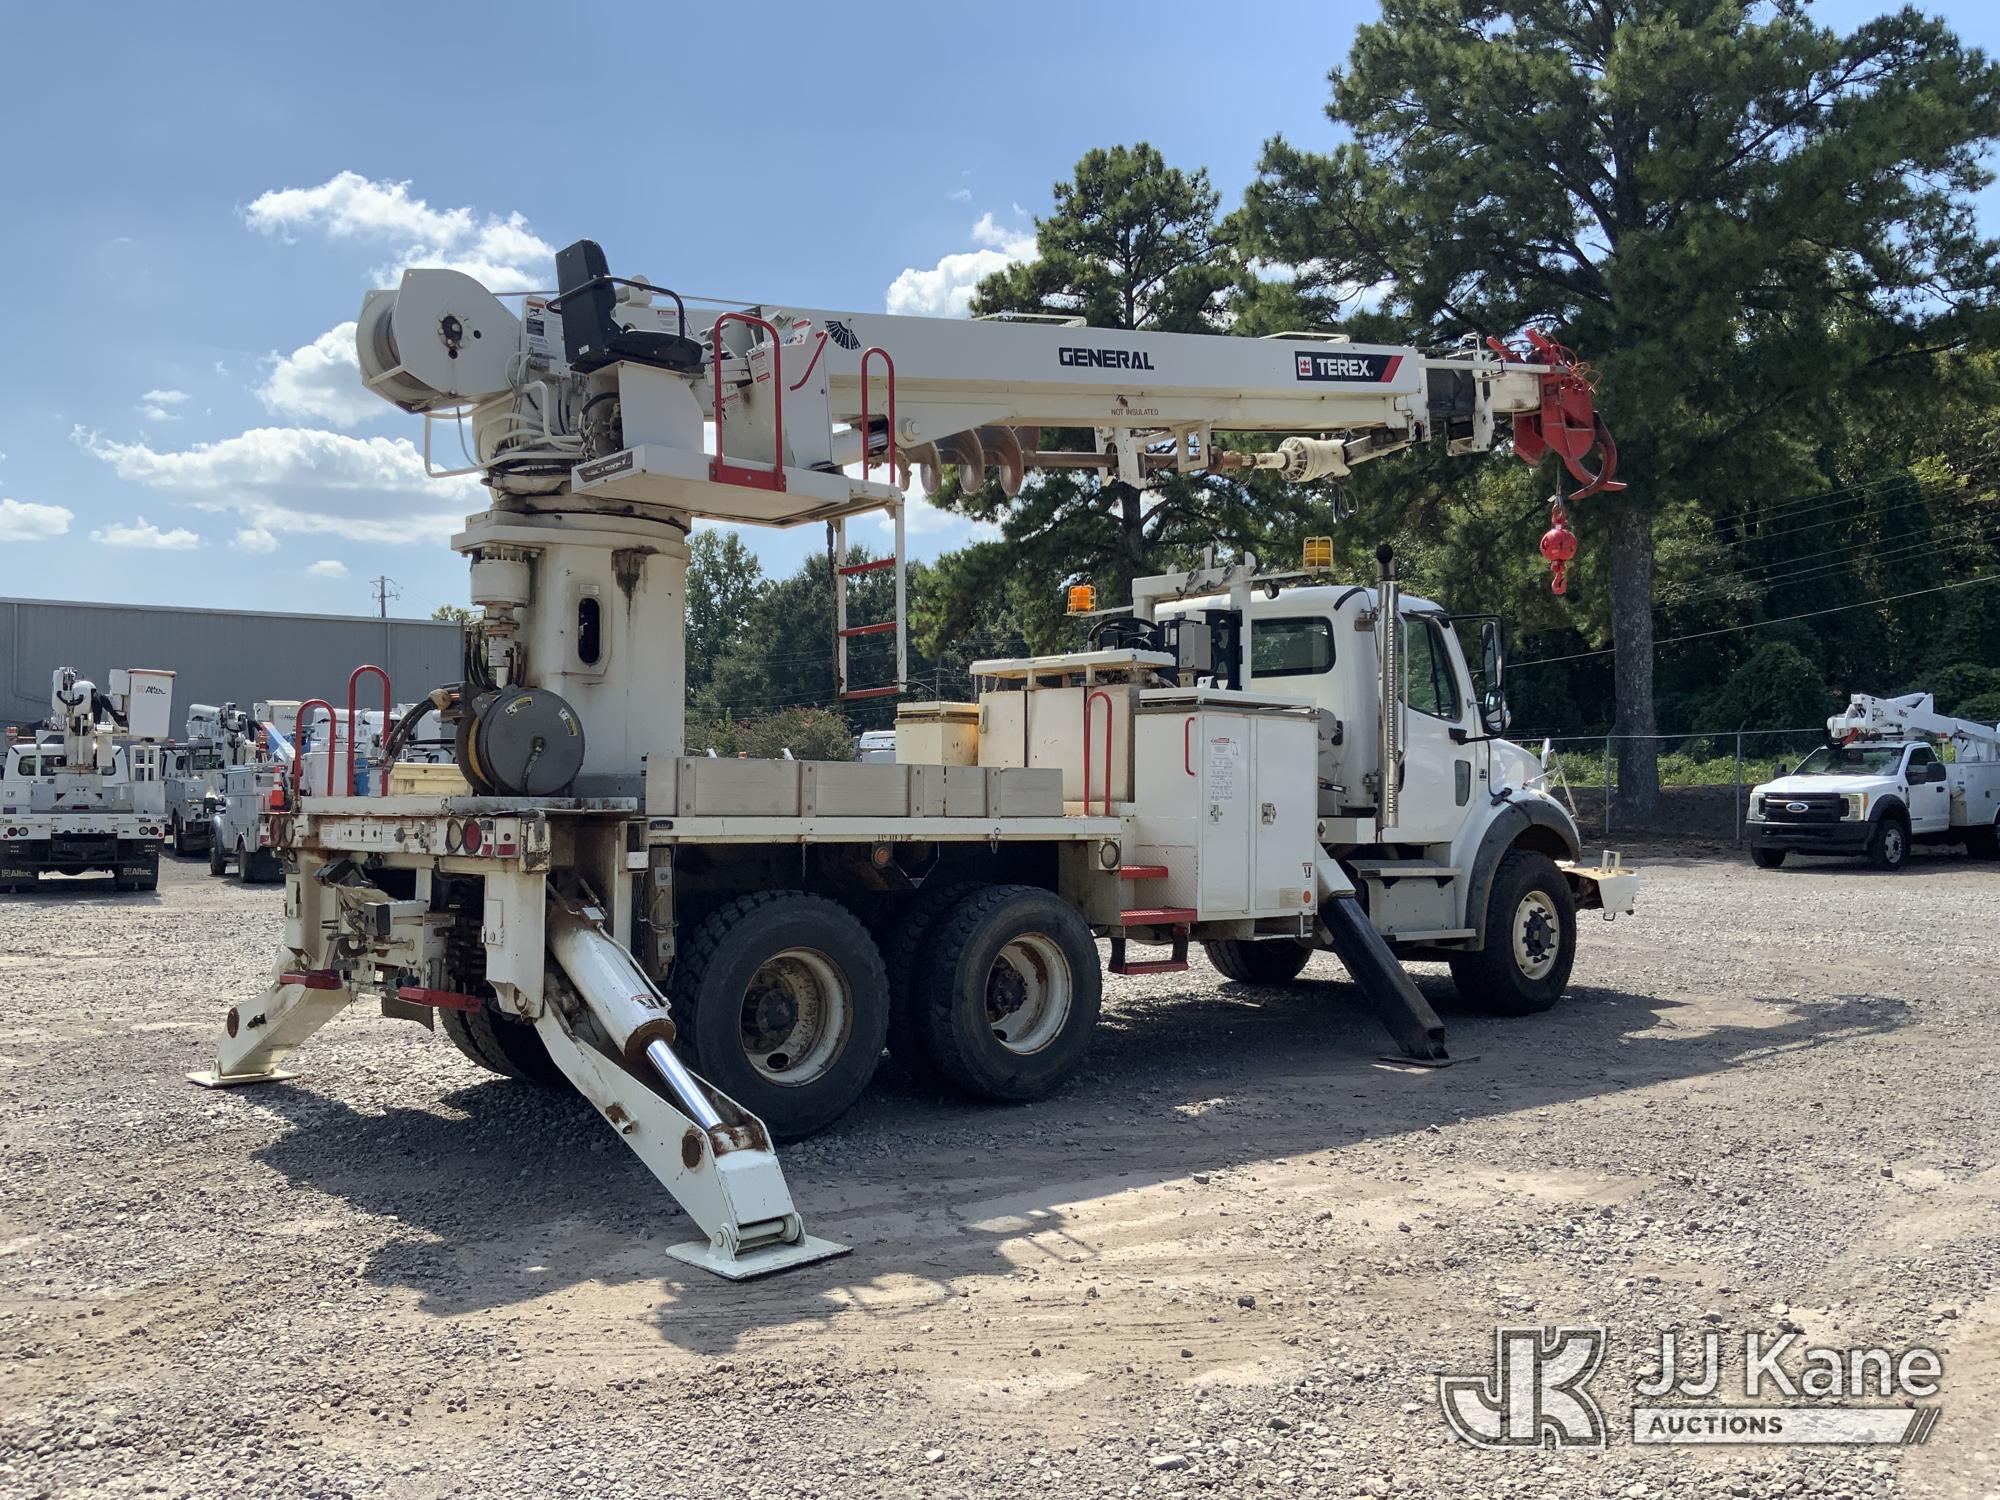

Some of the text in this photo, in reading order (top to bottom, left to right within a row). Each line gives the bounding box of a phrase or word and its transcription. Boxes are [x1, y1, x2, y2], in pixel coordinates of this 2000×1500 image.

[1058, 347, 1155, 371] GENERAL
[1316, 358, 1370, 377] TEREX
[1111, 408, 1159, 416] NOT INSULATED
